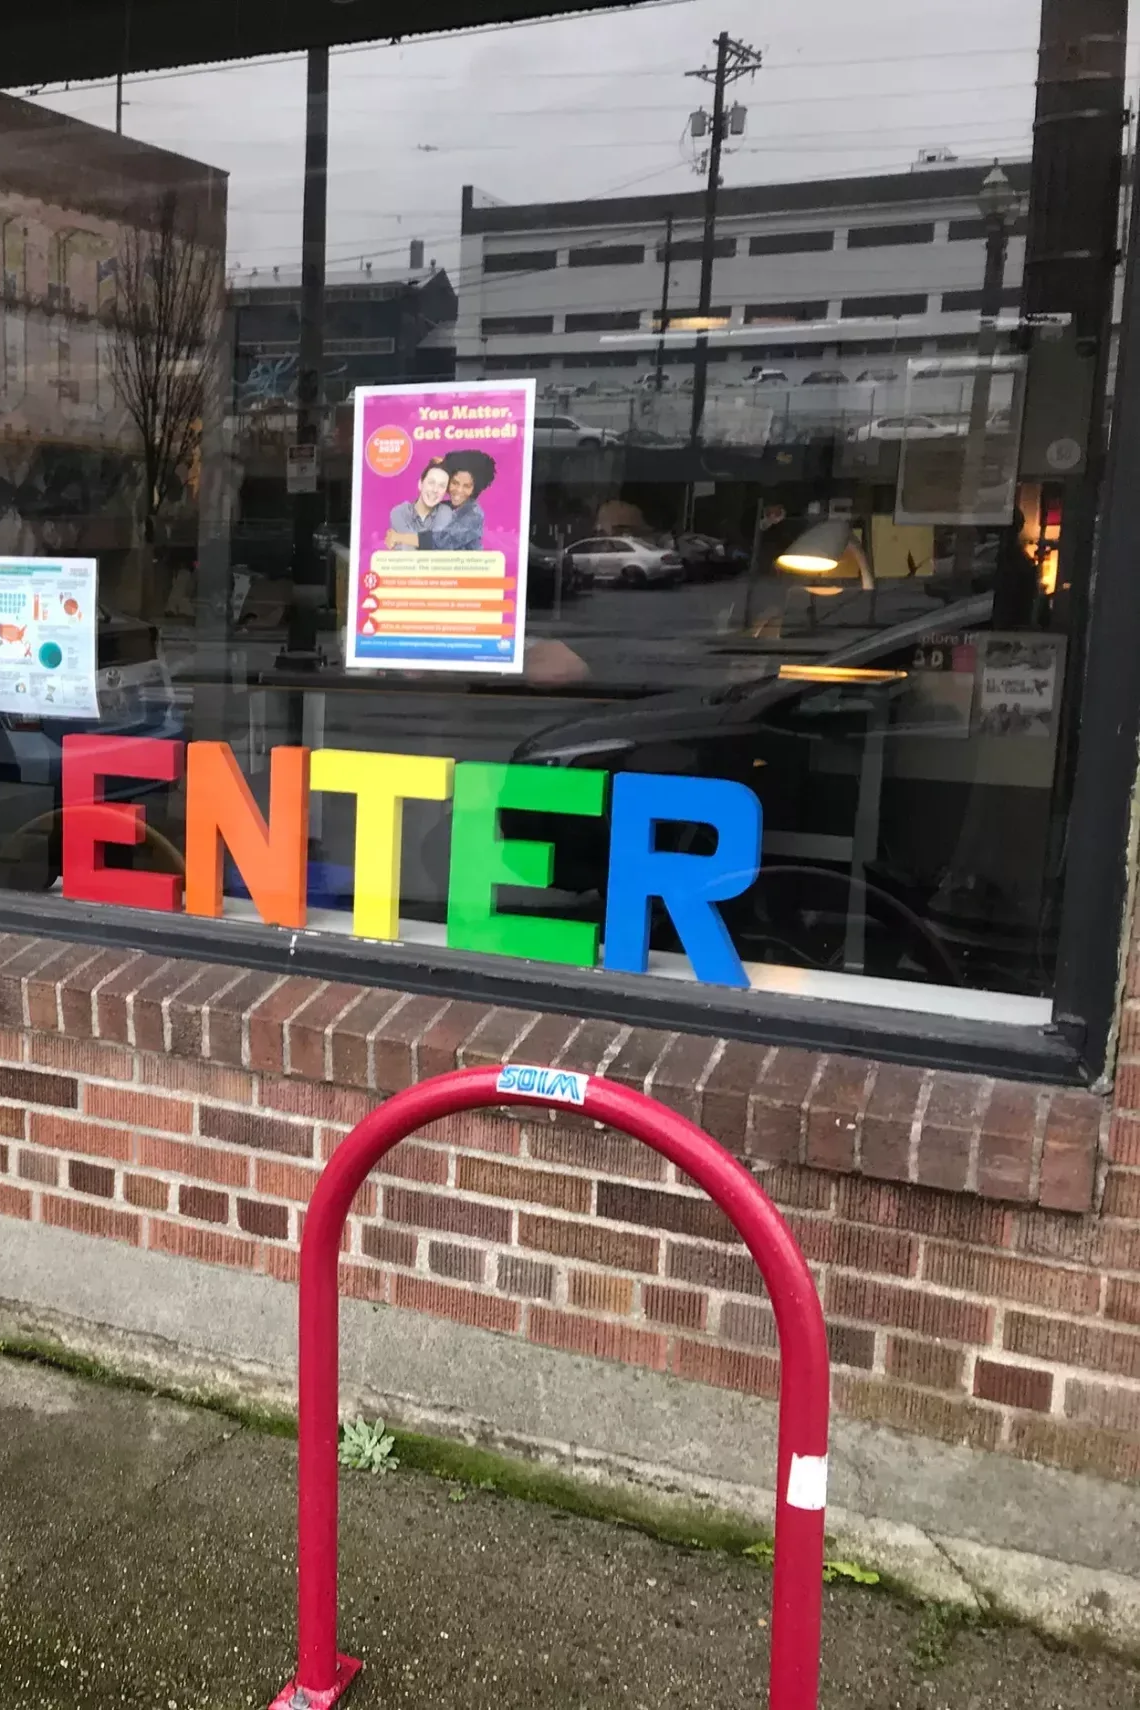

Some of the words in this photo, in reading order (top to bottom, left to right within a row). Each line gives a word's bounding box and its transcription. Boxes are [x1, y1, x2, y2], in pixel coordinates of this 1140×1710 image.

[418, 406, 449, 421] You
[413, 426, 441, 441] Get
[444, 423, 518, 441] Counted!
